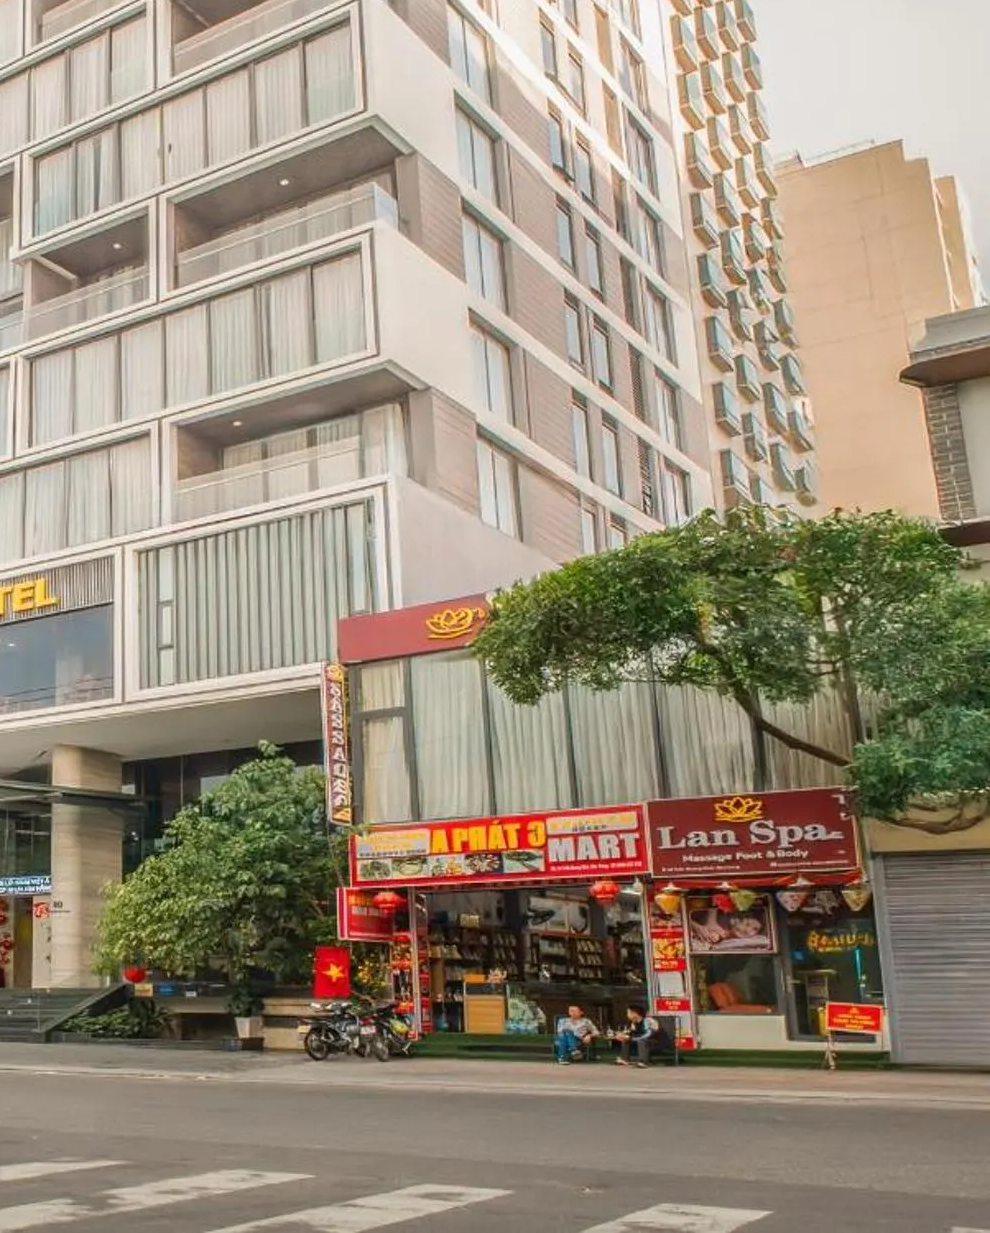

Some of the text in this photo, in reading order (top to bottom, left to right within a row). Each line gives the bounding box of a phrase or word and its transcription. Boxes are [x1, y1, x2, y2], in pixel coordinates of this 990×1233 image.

[527, 821, 547, 848] 3
[548, 832, 640, 863] MART
[656, 819, 832, 850] Lan Spa
[682, 853, 733, 864] Massage
[736, 851, 763, 861] Foot
[777, 849, 809, 860] Body
